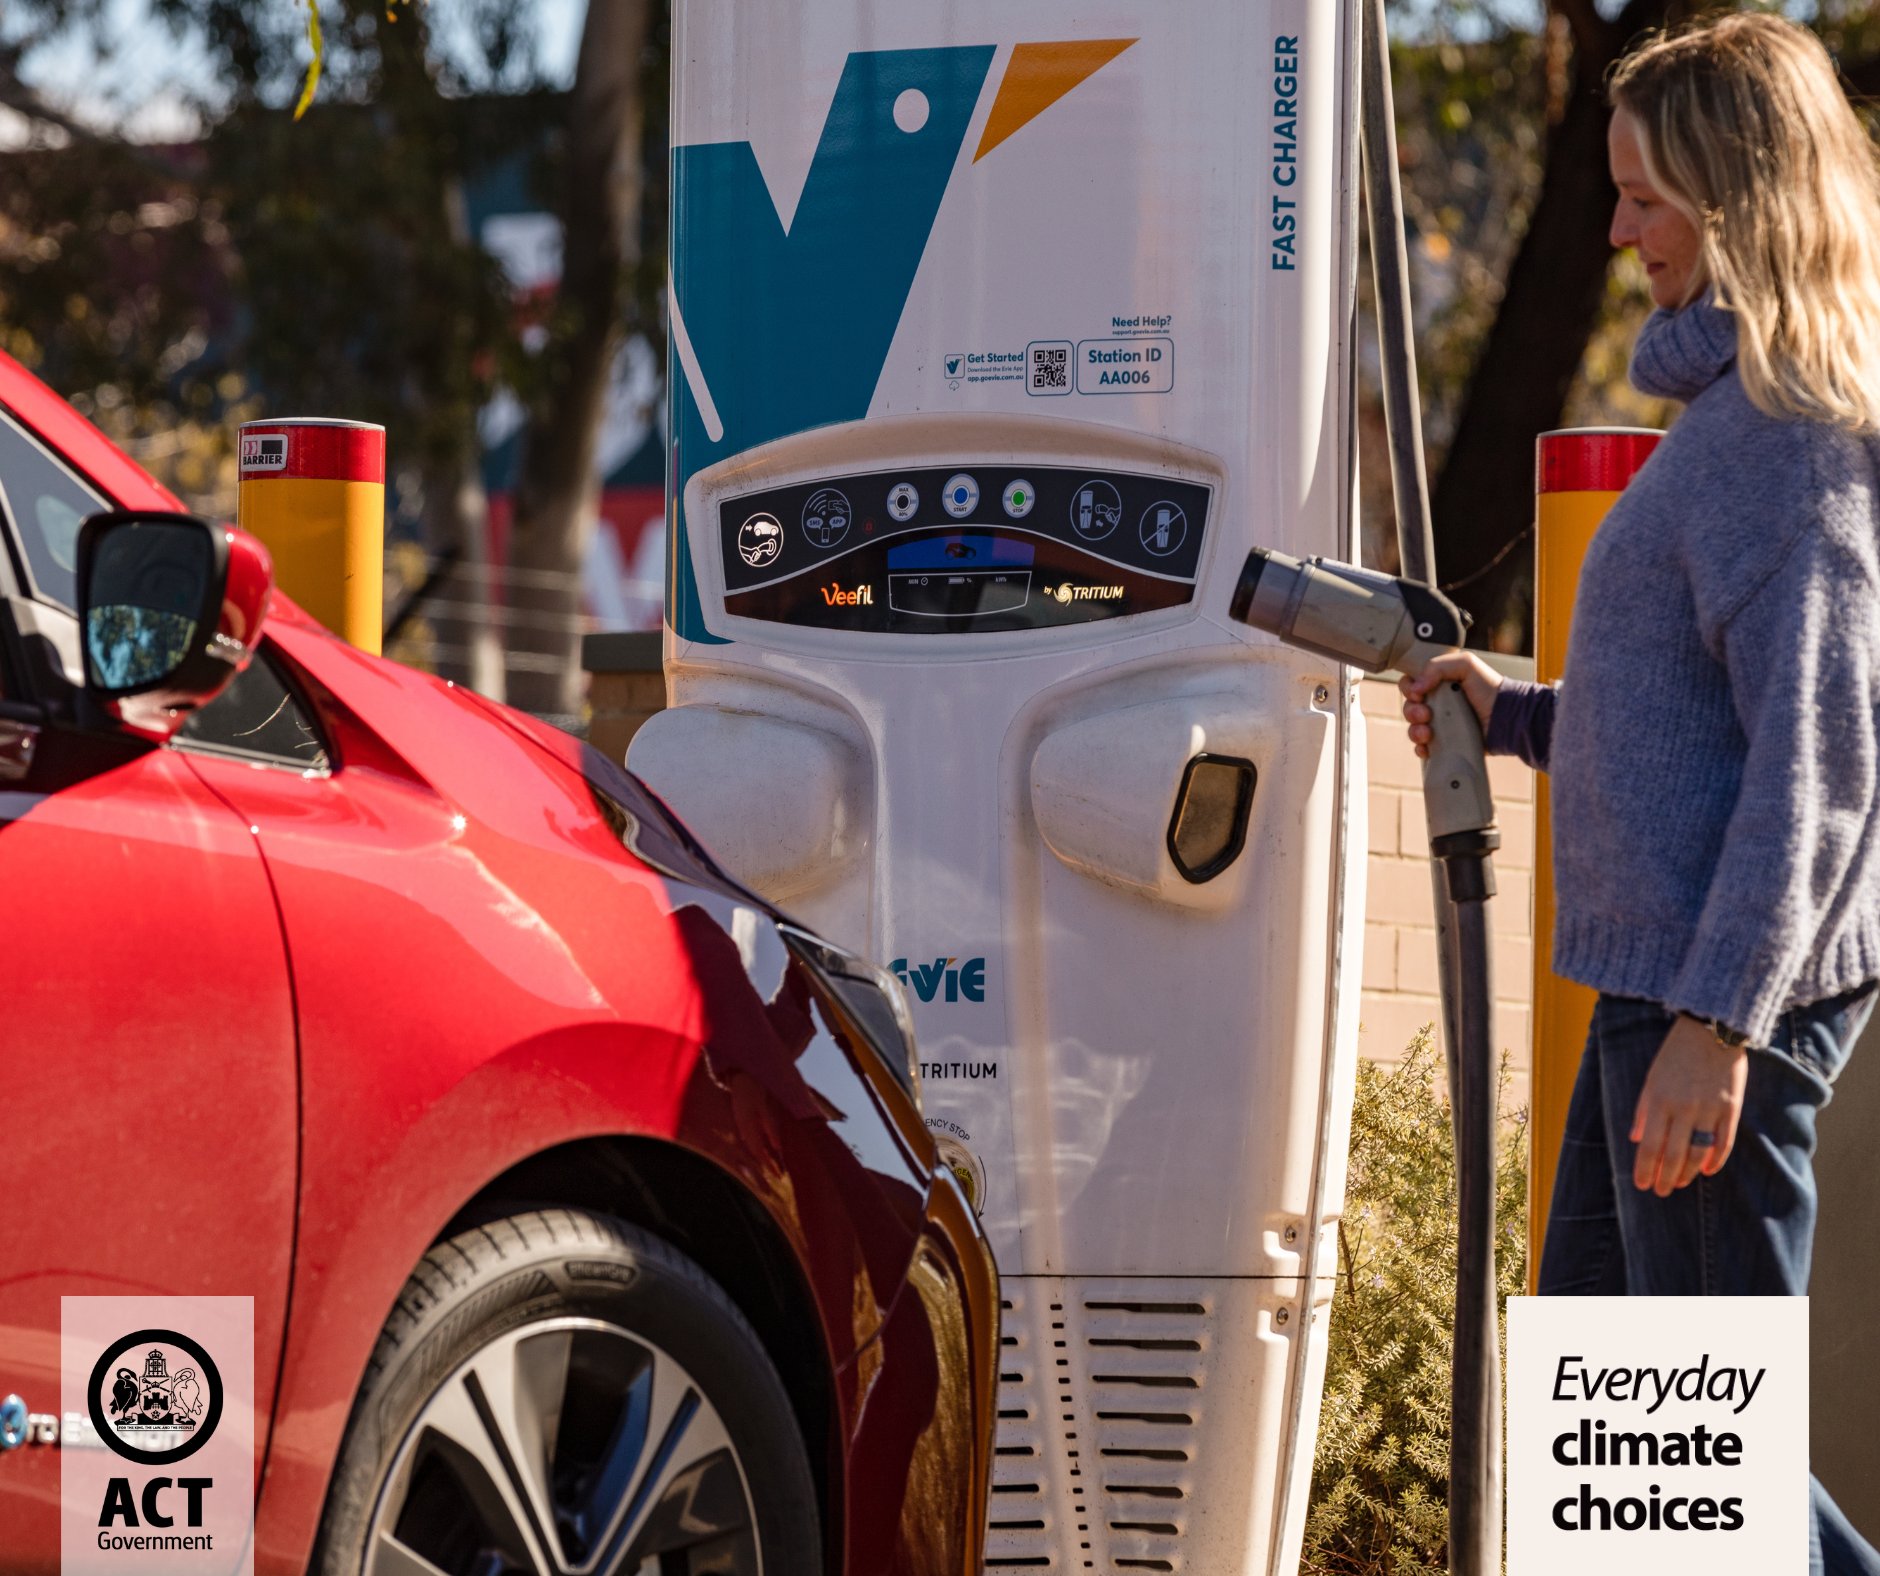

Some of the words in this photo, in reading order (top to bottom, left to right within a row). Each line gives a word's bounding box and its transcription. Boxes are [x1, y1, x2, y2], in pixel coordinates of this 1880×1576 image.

[1273, 35, 1298, 187] CHARGER
[1272, 195, 1296, 271] FAST
[1112, 315, 1140, 327] Need
[1142, 315, 1172, 329] Help?
[967, 353, 985, 363] Get
[987, 352, 1024, 363] Started
[1088, 349, 1141, 363] Station
[1146, 348, 1162, 362] ID
[1099, 370, 1150, 385] AA006
[243, 455, 283, 466] BARRIER
[821, 582, 874, 606] Veefil
[1043, 586, 1053, 595] by
[1073, 586, 1124, 600] TRITIUM
[920, 1062, 997, 1079] TRITIUM
[949, 1123, 971, 1141] STOP
